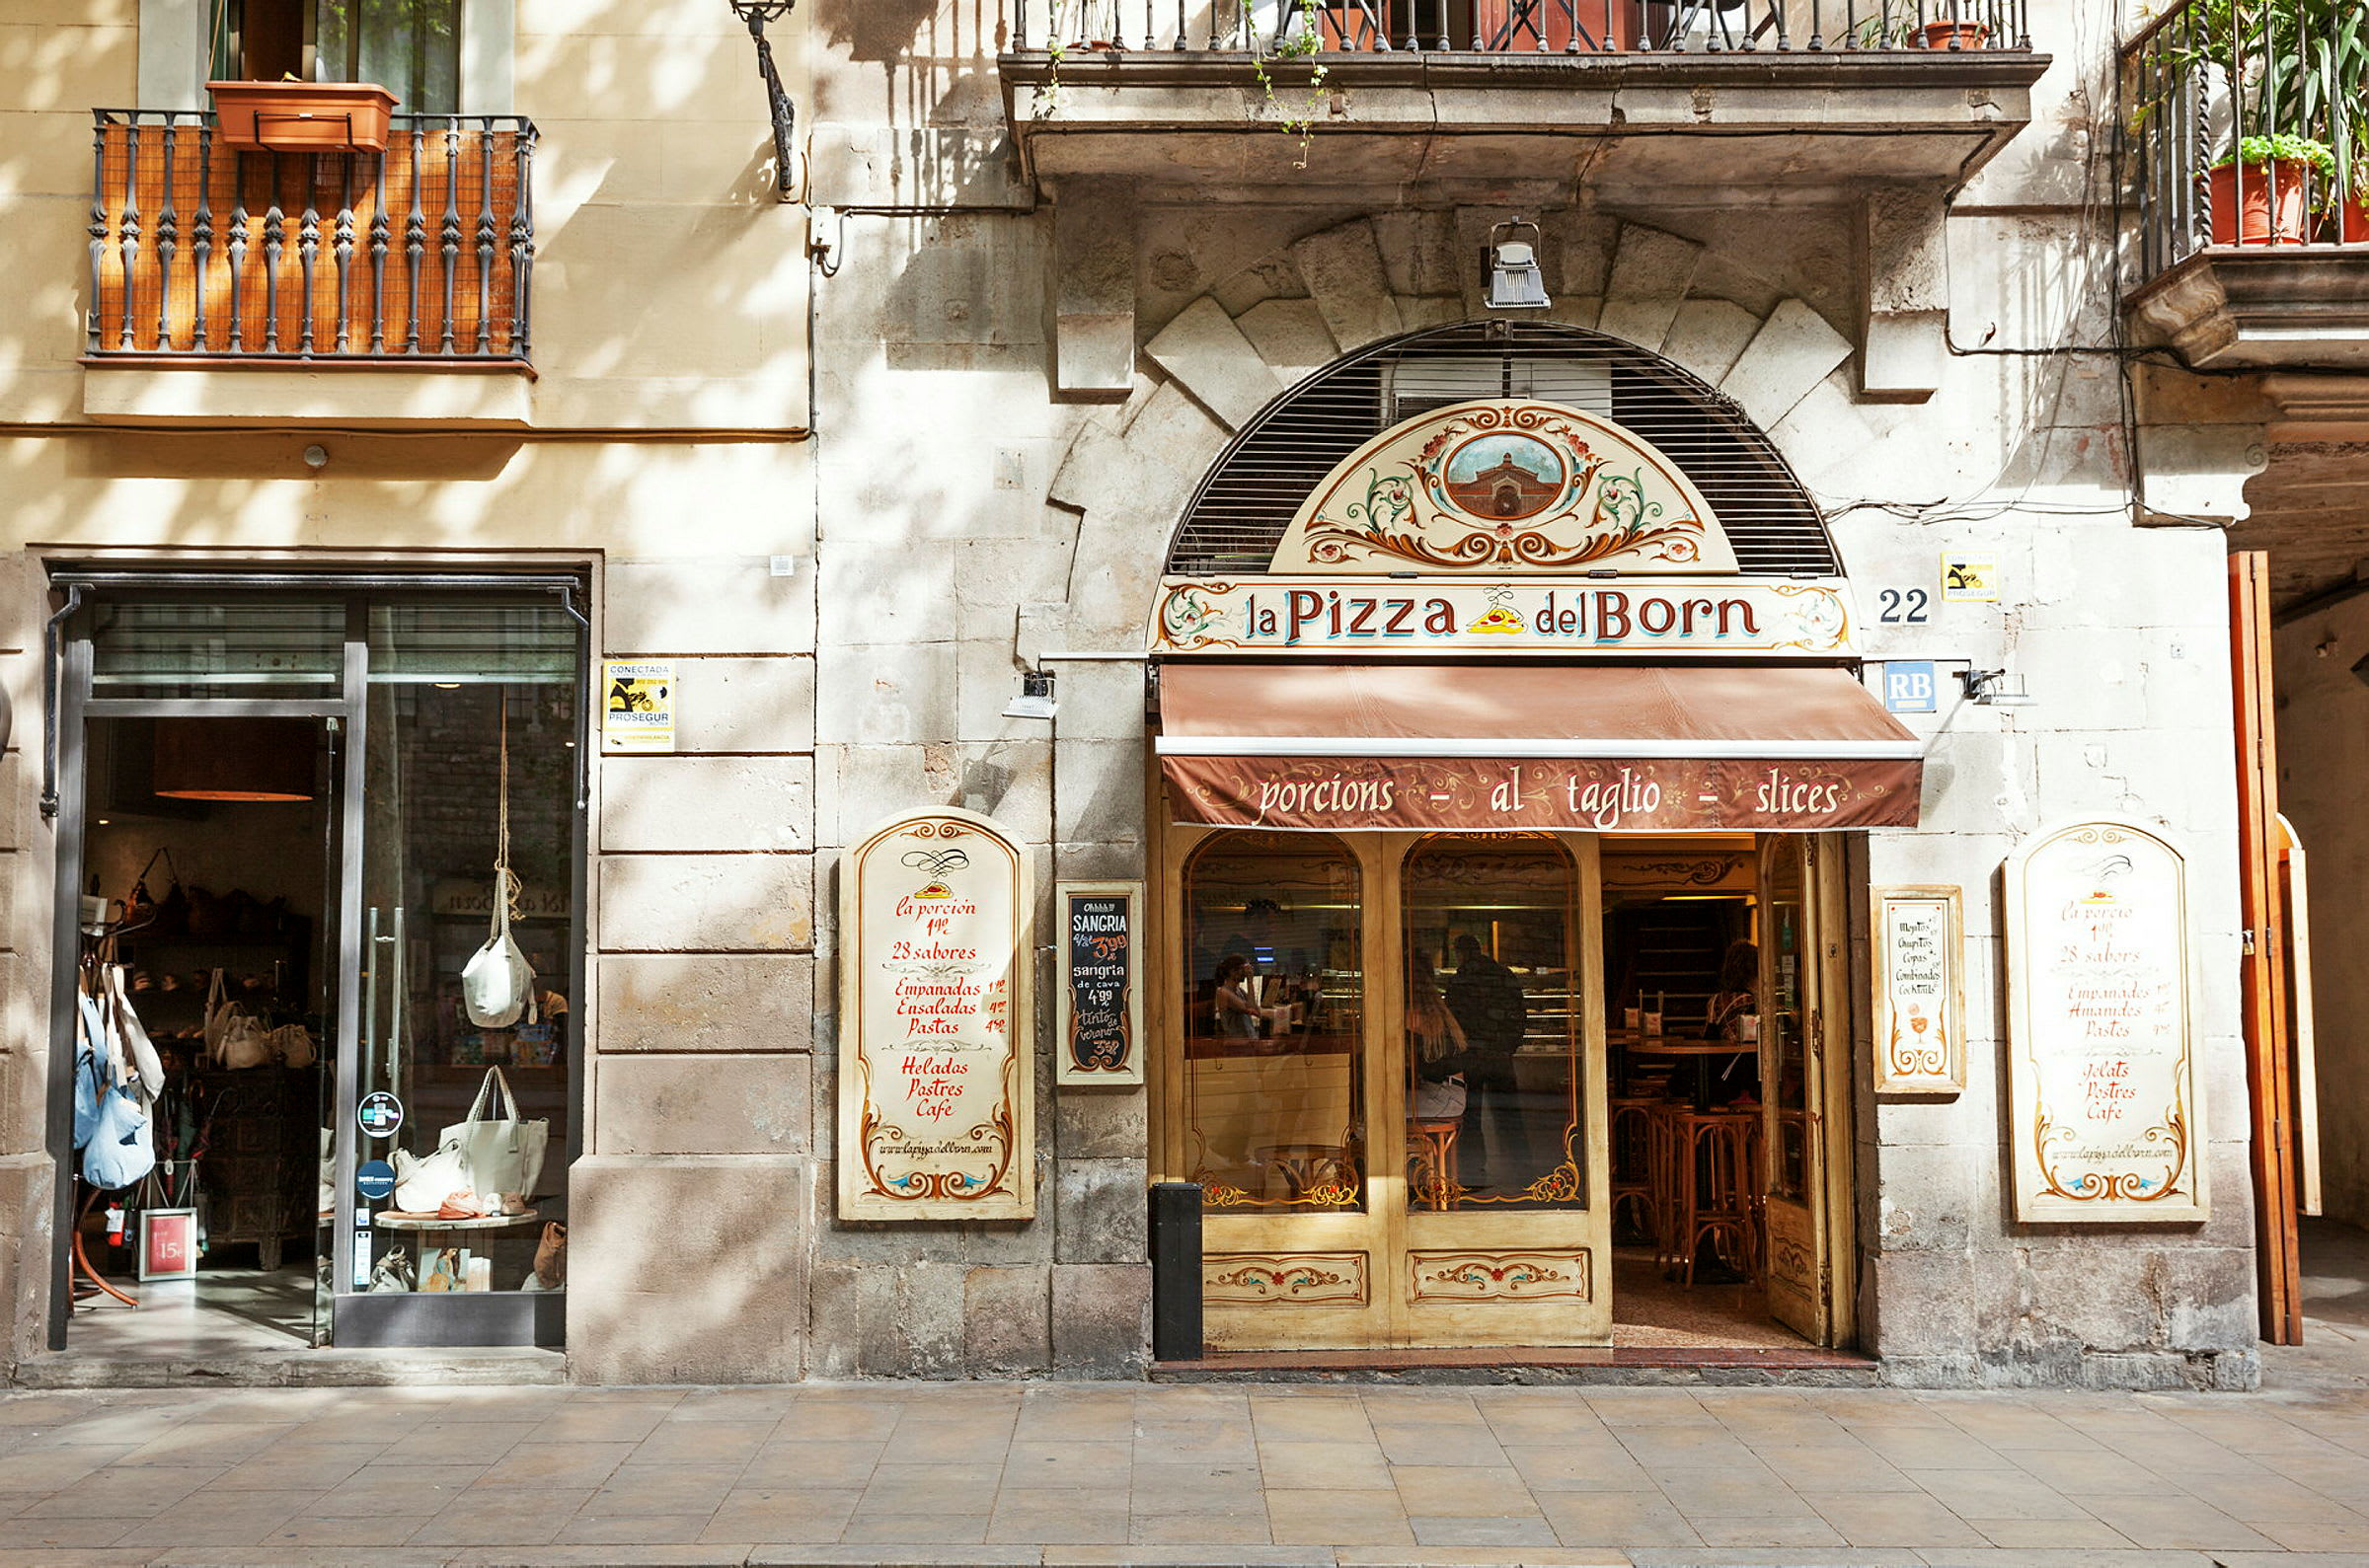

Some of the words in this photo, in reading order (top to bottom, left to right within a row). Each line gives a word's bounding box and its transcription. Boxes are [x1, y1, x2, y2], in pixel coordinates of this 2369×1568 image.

[1879, 588, 1928, 623] 22
[1247, 593, 1277, 638] la
[1284, 590, 1458, 646] Pizza
[1534, 590, 1586, 637] del
[1592, 591, 1761, 643] Born
[1889, 674, 1932, 700] RB
[1251, 773, 1395, 826] porcions
[1491, 765, 1525, 812] al
[1567, 767, 1660, 829] taglio
[1755, 767, 1839, 813] slices
[1073, 915, 1126, 932] SANGRIA
[892, 940, 911, 959] 28
[913, 941, 976, 959] sabores
[1073, 964, 1124, 979] sangria
[895, 977, 981, 1001] Empanadas
[896, 997, 976, 1014] Ensaladas
[907, 1017, 959, 1038] Pastas
